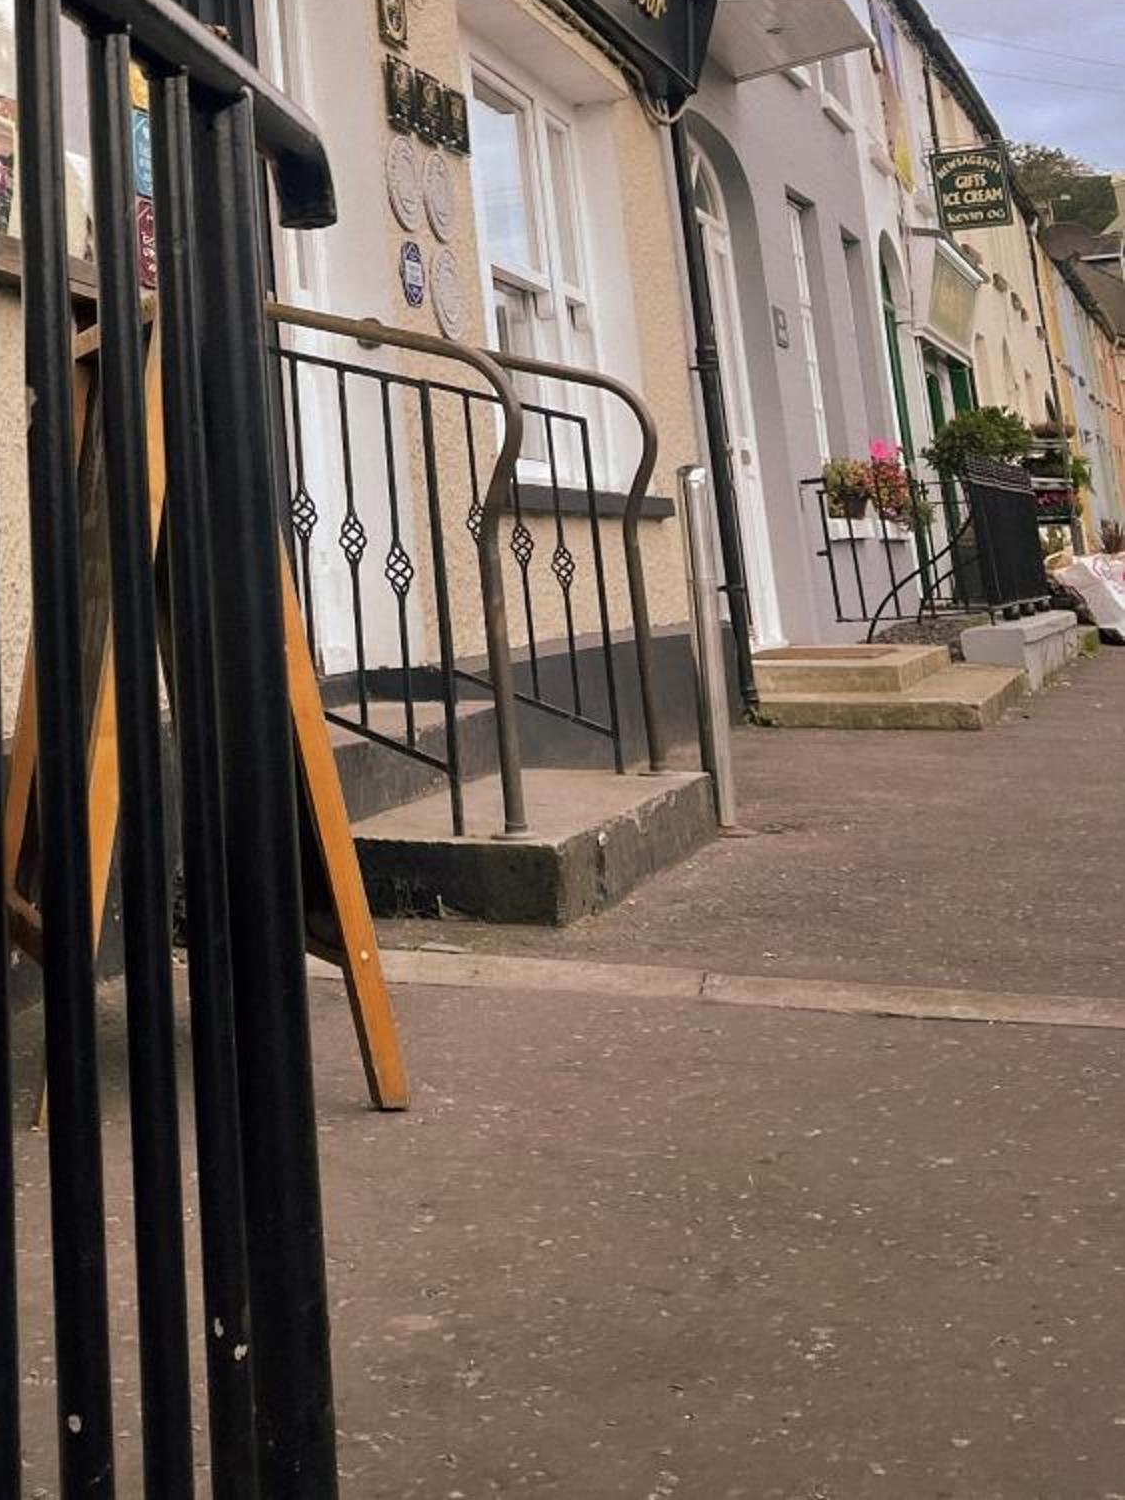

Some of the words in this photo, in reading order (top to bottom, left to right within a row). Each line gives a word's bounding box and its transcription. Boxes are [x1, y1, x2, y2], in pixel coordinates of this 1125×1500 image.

[955, 173, 987, 189] GIFTS
[943, 191, 961, 207] ICE
[963, 187, 1004, 205] CREAM
